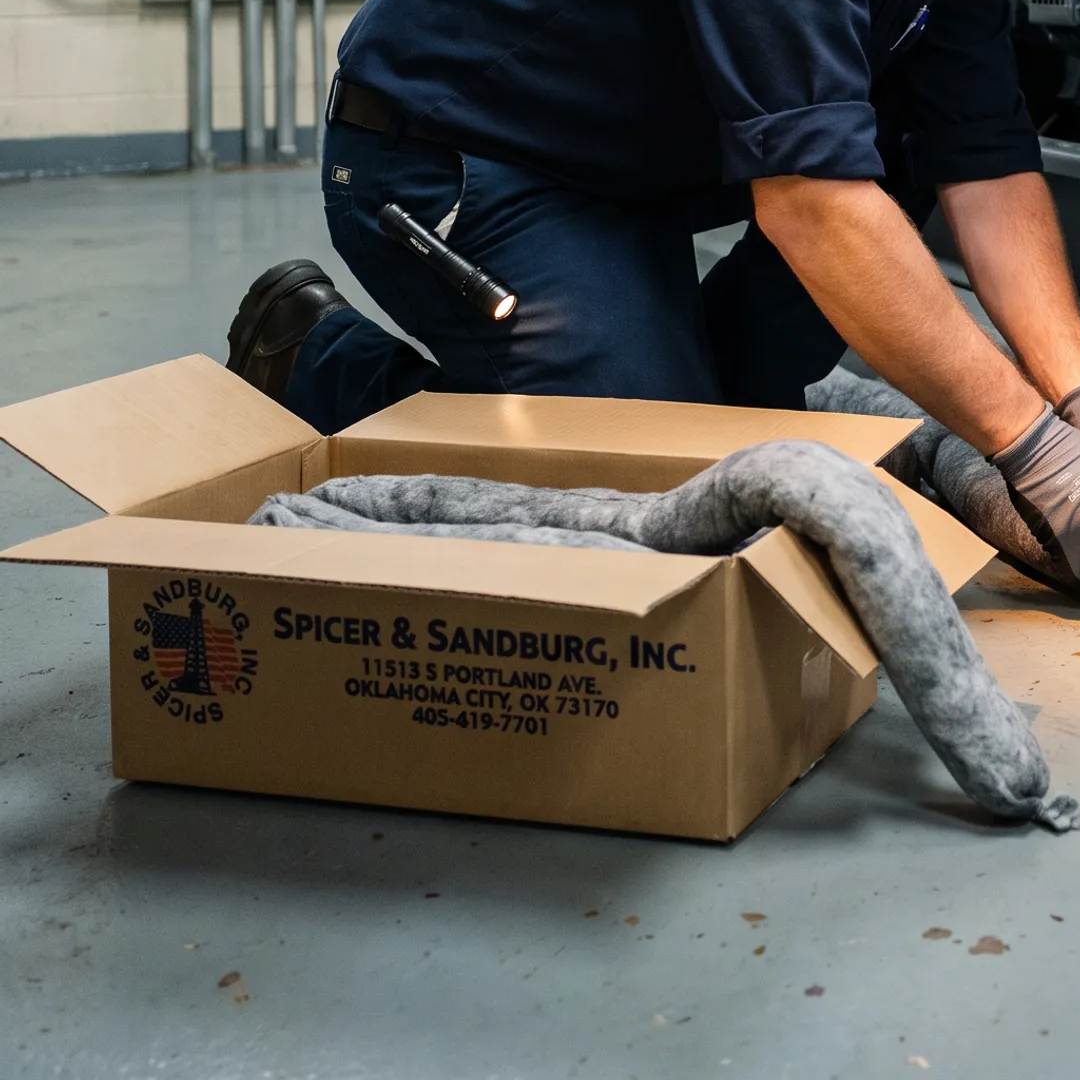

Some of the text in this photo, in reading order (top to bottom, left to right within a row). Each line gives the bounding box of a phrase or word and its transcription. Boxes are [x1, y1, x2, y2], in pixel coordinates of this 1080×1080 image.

[391, 617, 417, 650] &
[133, 645, 150, 662] &
[361, 657, 602, 696] 11513 S PORTLAND AVE.
[140, 670, 224, 724] SPICER
[344, 678, 620, 720] OKLAHOMA CITY, OK 73170
[411, 706, 548, 736] 405-419-7701
